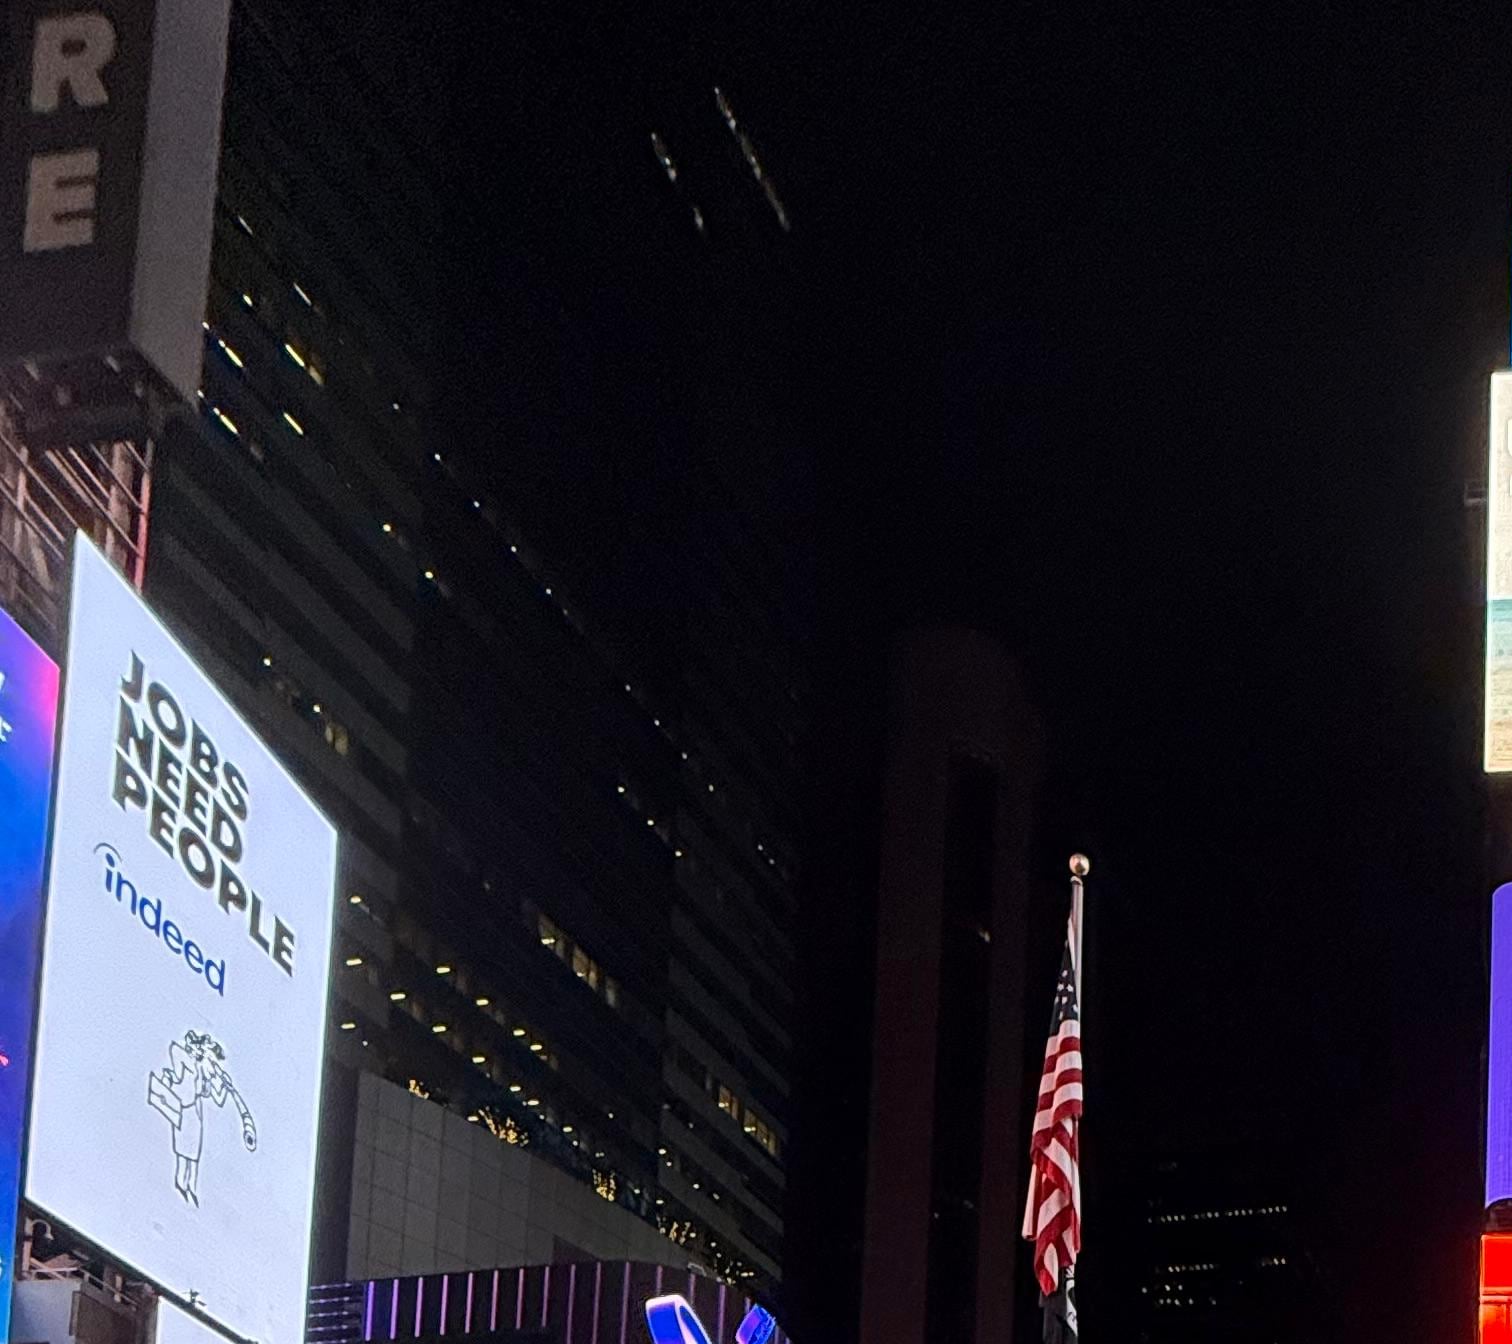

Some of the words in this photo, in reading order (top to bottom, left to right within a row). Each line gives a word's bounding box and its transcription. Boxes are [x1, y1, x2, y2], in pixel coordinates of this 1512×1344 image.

[115, 695, 243, 867] NEED
[119, 650, 249, 822] JOBS
[93, 842, 226, 998] indeed
[112, 763, 295, 978] PEOPLE
